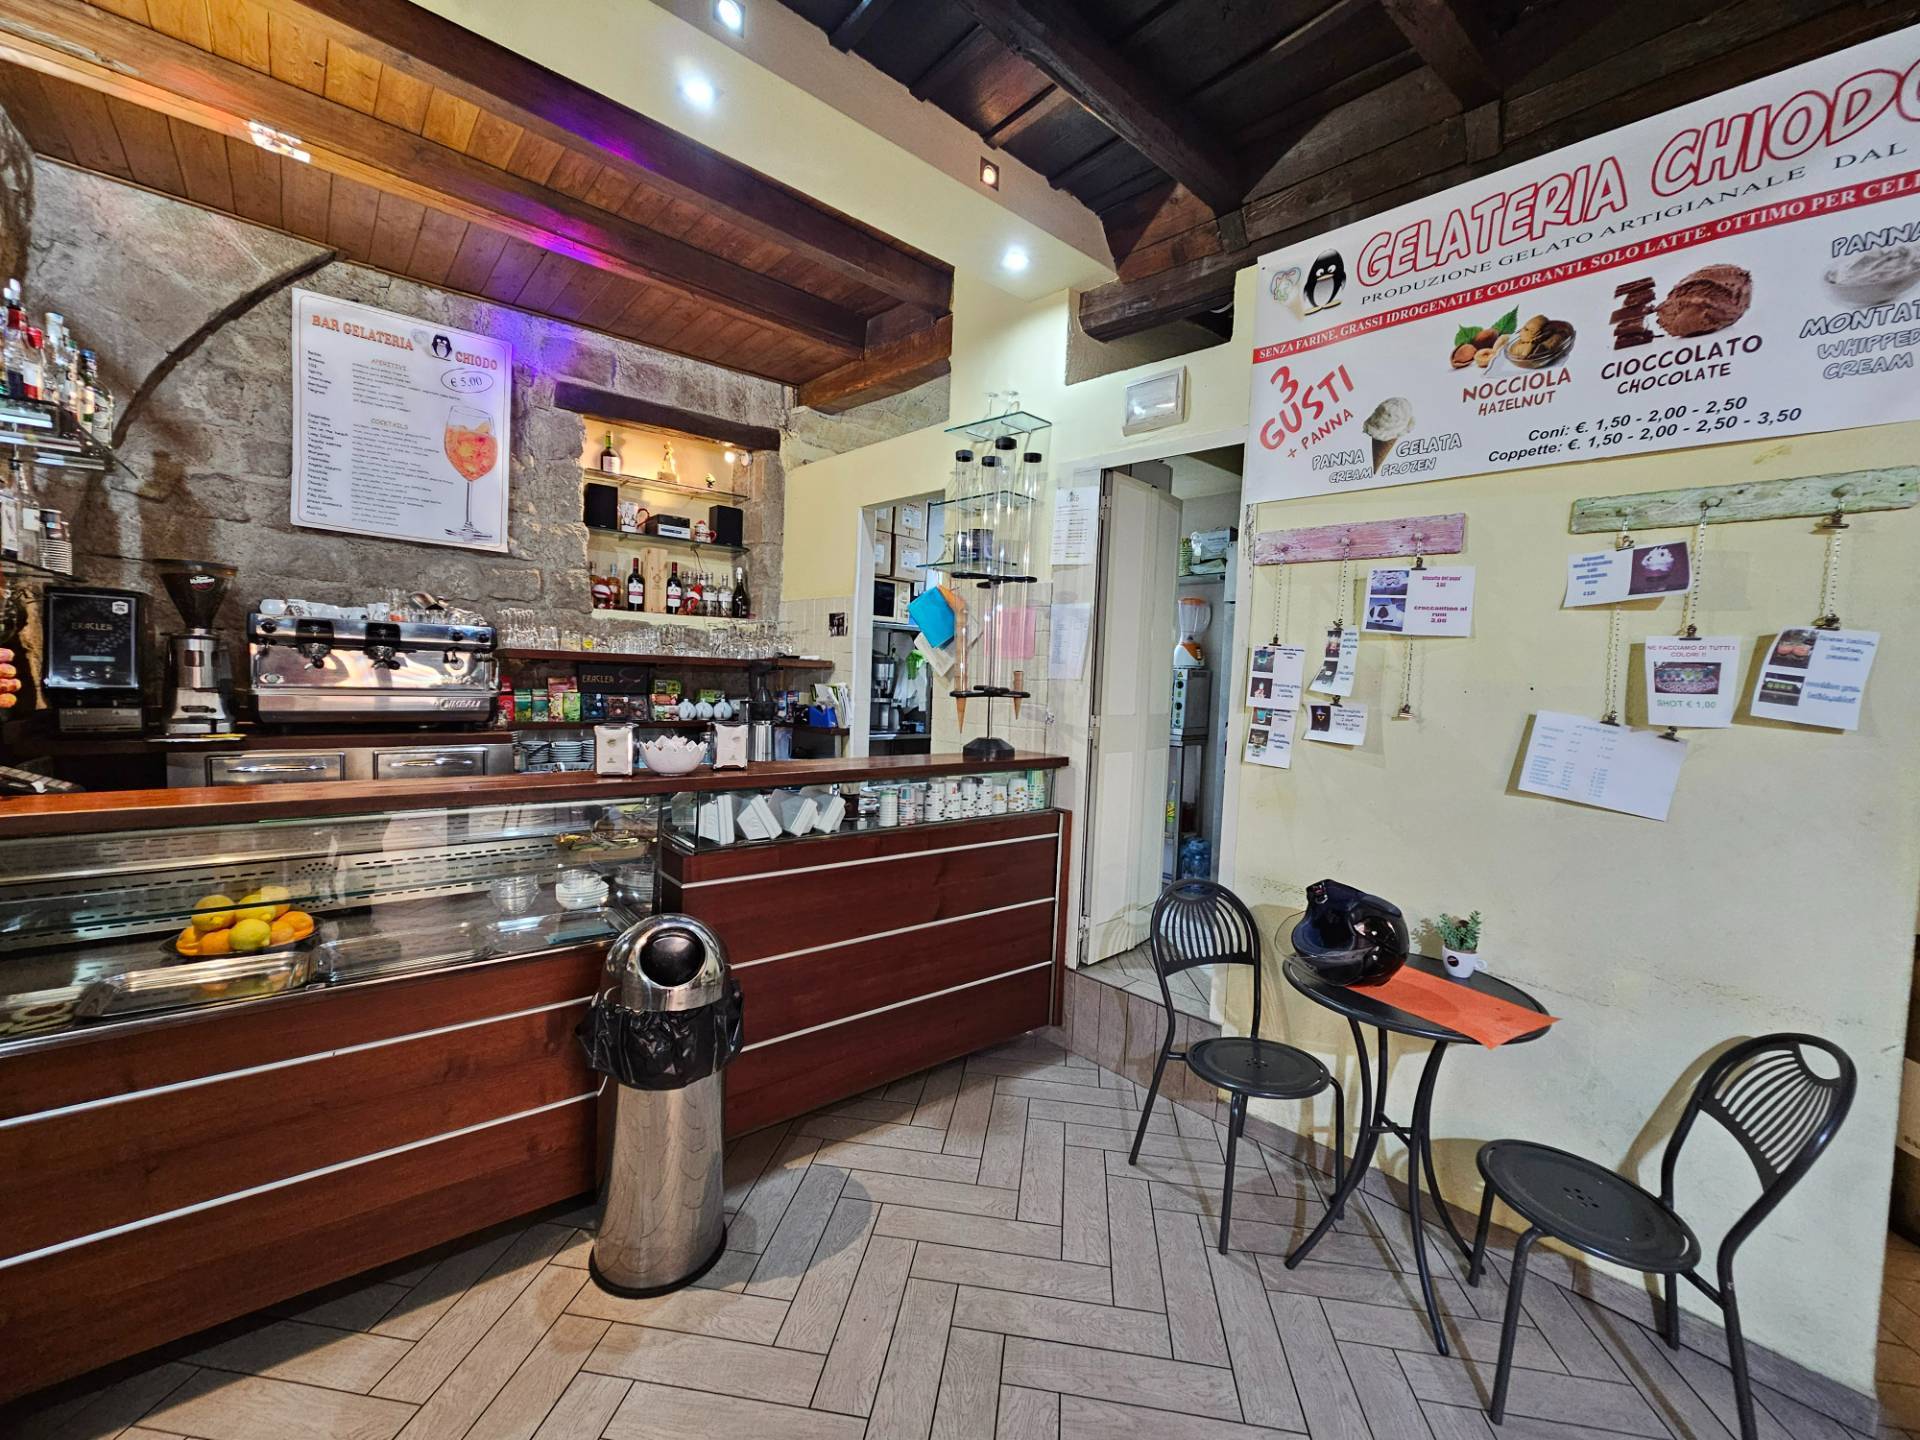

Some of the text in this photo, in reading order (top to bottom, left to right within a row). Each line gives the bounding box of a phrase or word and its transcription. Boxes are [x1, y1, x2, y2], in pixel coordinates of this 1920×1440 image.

[1356, 156, 1628, 287] GELATERIA
[1361, 143, 1908, 305] PRODUZIONE GELATO ARTIGIANALE DAL
[1259, 341, 1295, 359] SENZA
[1295, 329, 1338, 350] FARINE,
[1340, 316, 1384, 336] GRASSI
[1386, 294, 1472, 326] IDROGENATI
[1474, 290, 1486, 303] E
[1487, 261, 1587, 297] COLORANTI.
[1590, 245, 1639, 269] SOLO
[1645, 228, 1712, 255] LATTE.
[1715, 201, 1806, 234] OTTIMO
[1811, 189, 1856, 212] PER
[311, 315, 413, 351] BAR GELATERIA
[455, 351, 498, 370] CHIODO
[1601, 334, 1763, 381] CIOCCOLATO
[1822, 352, 1913, 381] CREAM
[1270, 365, 1299, 404] 3
[1462, 367, 1572, 403] NOCCIOLA
[1617, 362, 1732, 395] CHOCOLATE
[1259, 364, 1355, 452] GUSTI
[1477, 390, 1557, 417] HAZELNUT
[1528, 424, 1569, 442] Coni:
[1597, 413, 1631, 431] 1,50
[1648, 405, 1688, 423] 2,00
[1704, 396, 1748, 415] 2,50
[1300, 408, 1354, 451] PANNA
[1488, 442, 1562, 464] Coppette:
[1588, 431, 1623, 449] 1,50
[1639, 423, 1677, 441] 2,00
[1695, 415, 1738, 434] 2,50
[1756, 407, 1802, 426] 3,50
[1312, 432, 1463, 471] PANNA GELATA
[1328, 457, 1436, 484] CREAM FROZEN
[1656, 699, 1684, 708] SHOT
